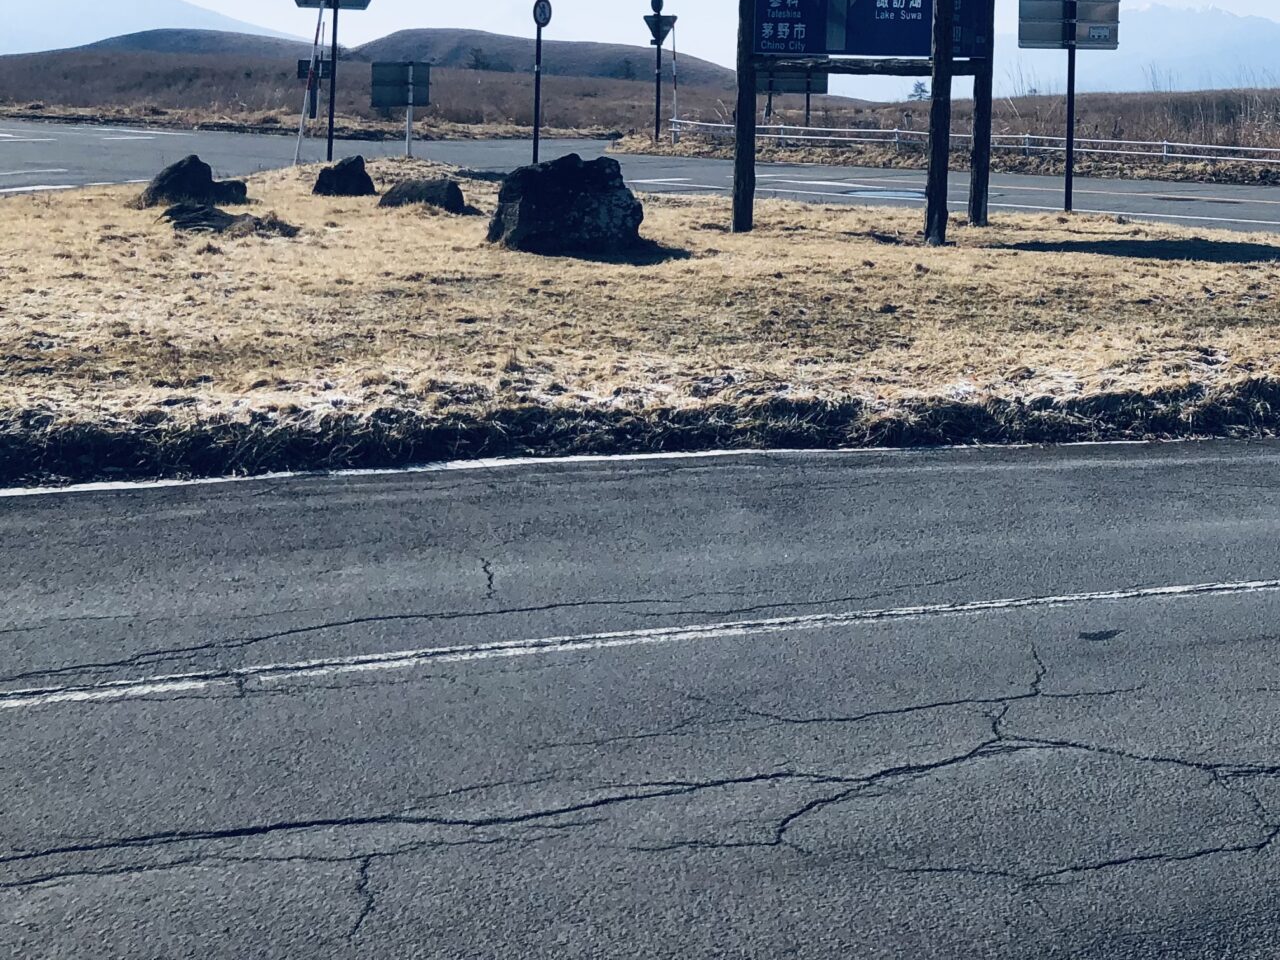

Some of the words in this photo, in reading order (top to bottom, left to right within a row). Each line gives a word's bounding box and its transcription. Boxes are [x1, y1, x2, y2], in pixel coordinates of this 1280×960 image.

[875, 10, 895, 19] Lake
[900, 10, 922, 20] Suwa
[761, 22, 806, 40] 茅野市
[760, 40, 785, 50] Chino
[788, 40, 806, 52] City
